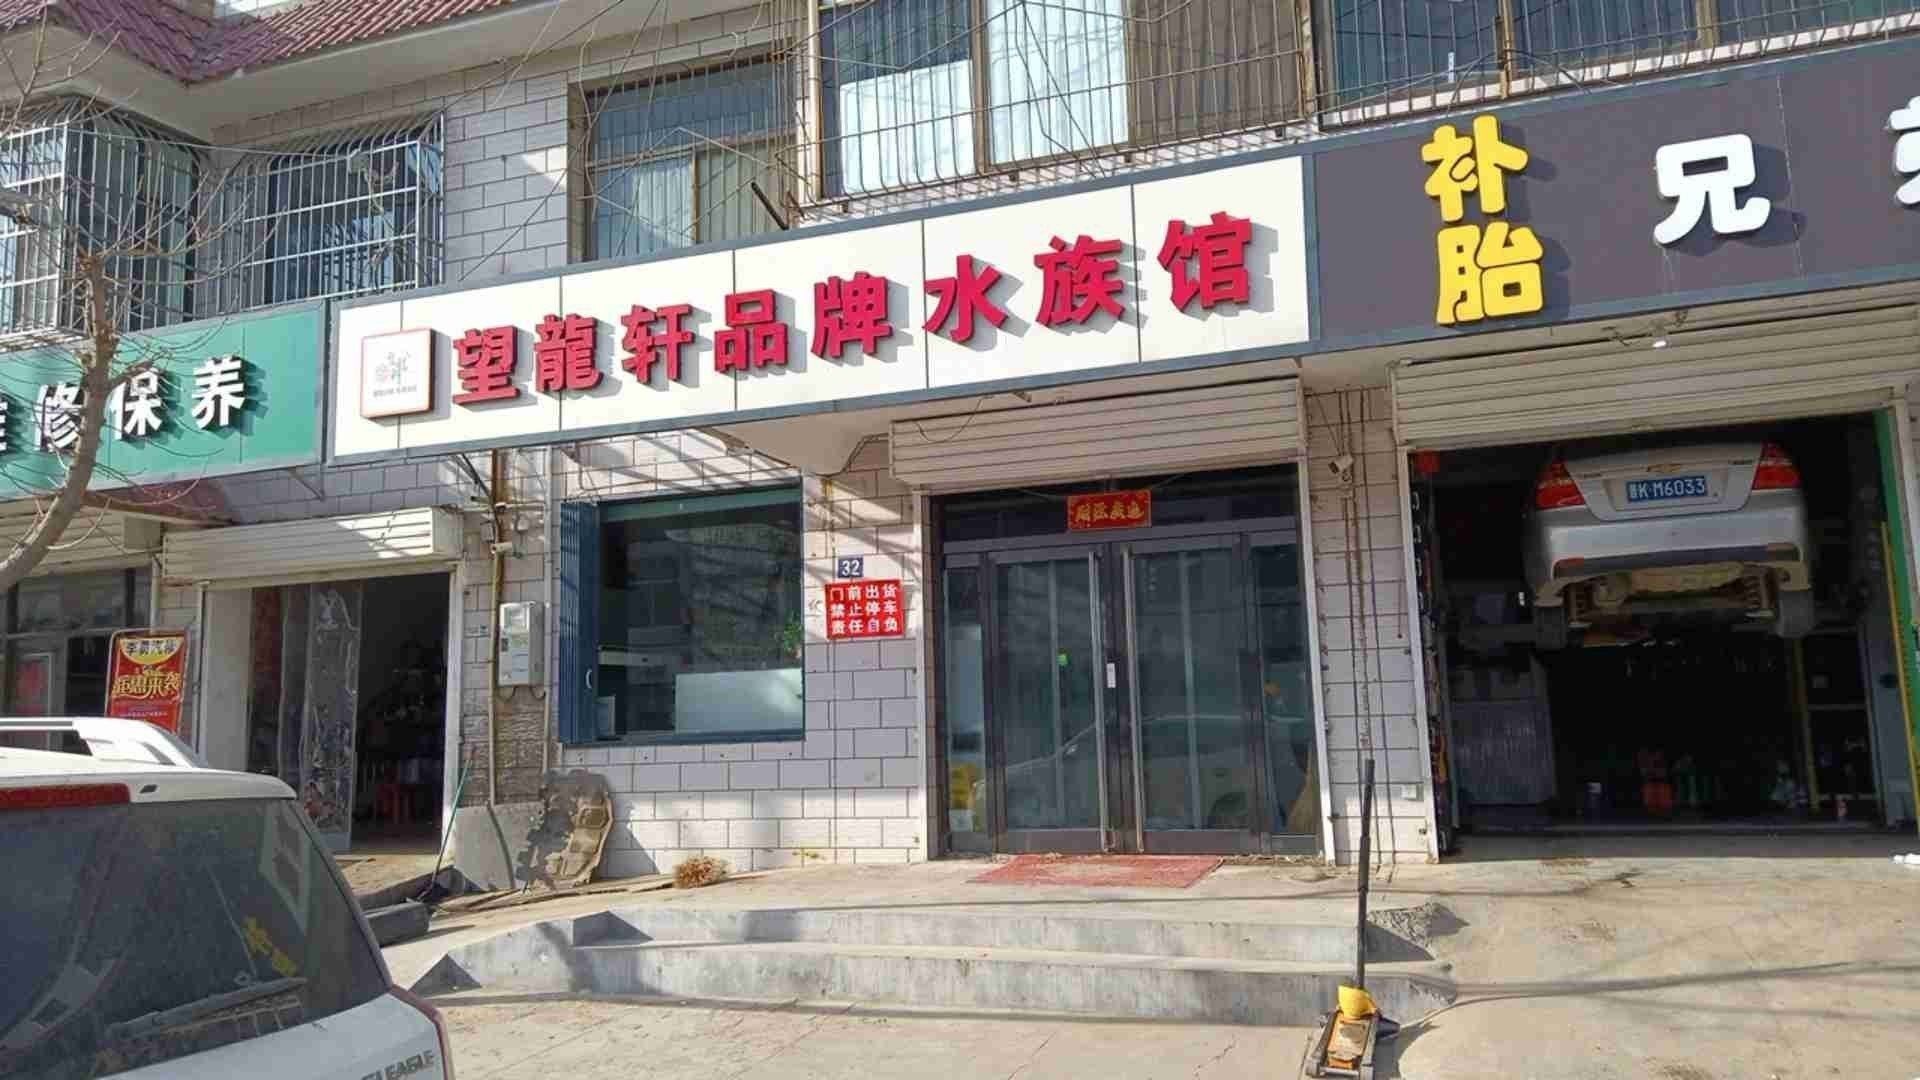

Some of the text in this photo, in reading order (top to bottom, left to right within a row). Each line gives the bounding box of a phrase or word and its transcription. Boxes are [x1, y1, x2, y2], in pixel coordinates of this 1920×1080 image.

[1420, 114, 1544, 325] 补胎
[452, 210, 1254, 406] 望龍轩品牌水族馆
[0, 355, 246, 454] 修保养
[841, 559, 861, 577] 32
[830, 583, 897, 600] 门前出货
[830, 600, 898, 618] 禁止停车
[830, 618, 898, 635] 责任自负
